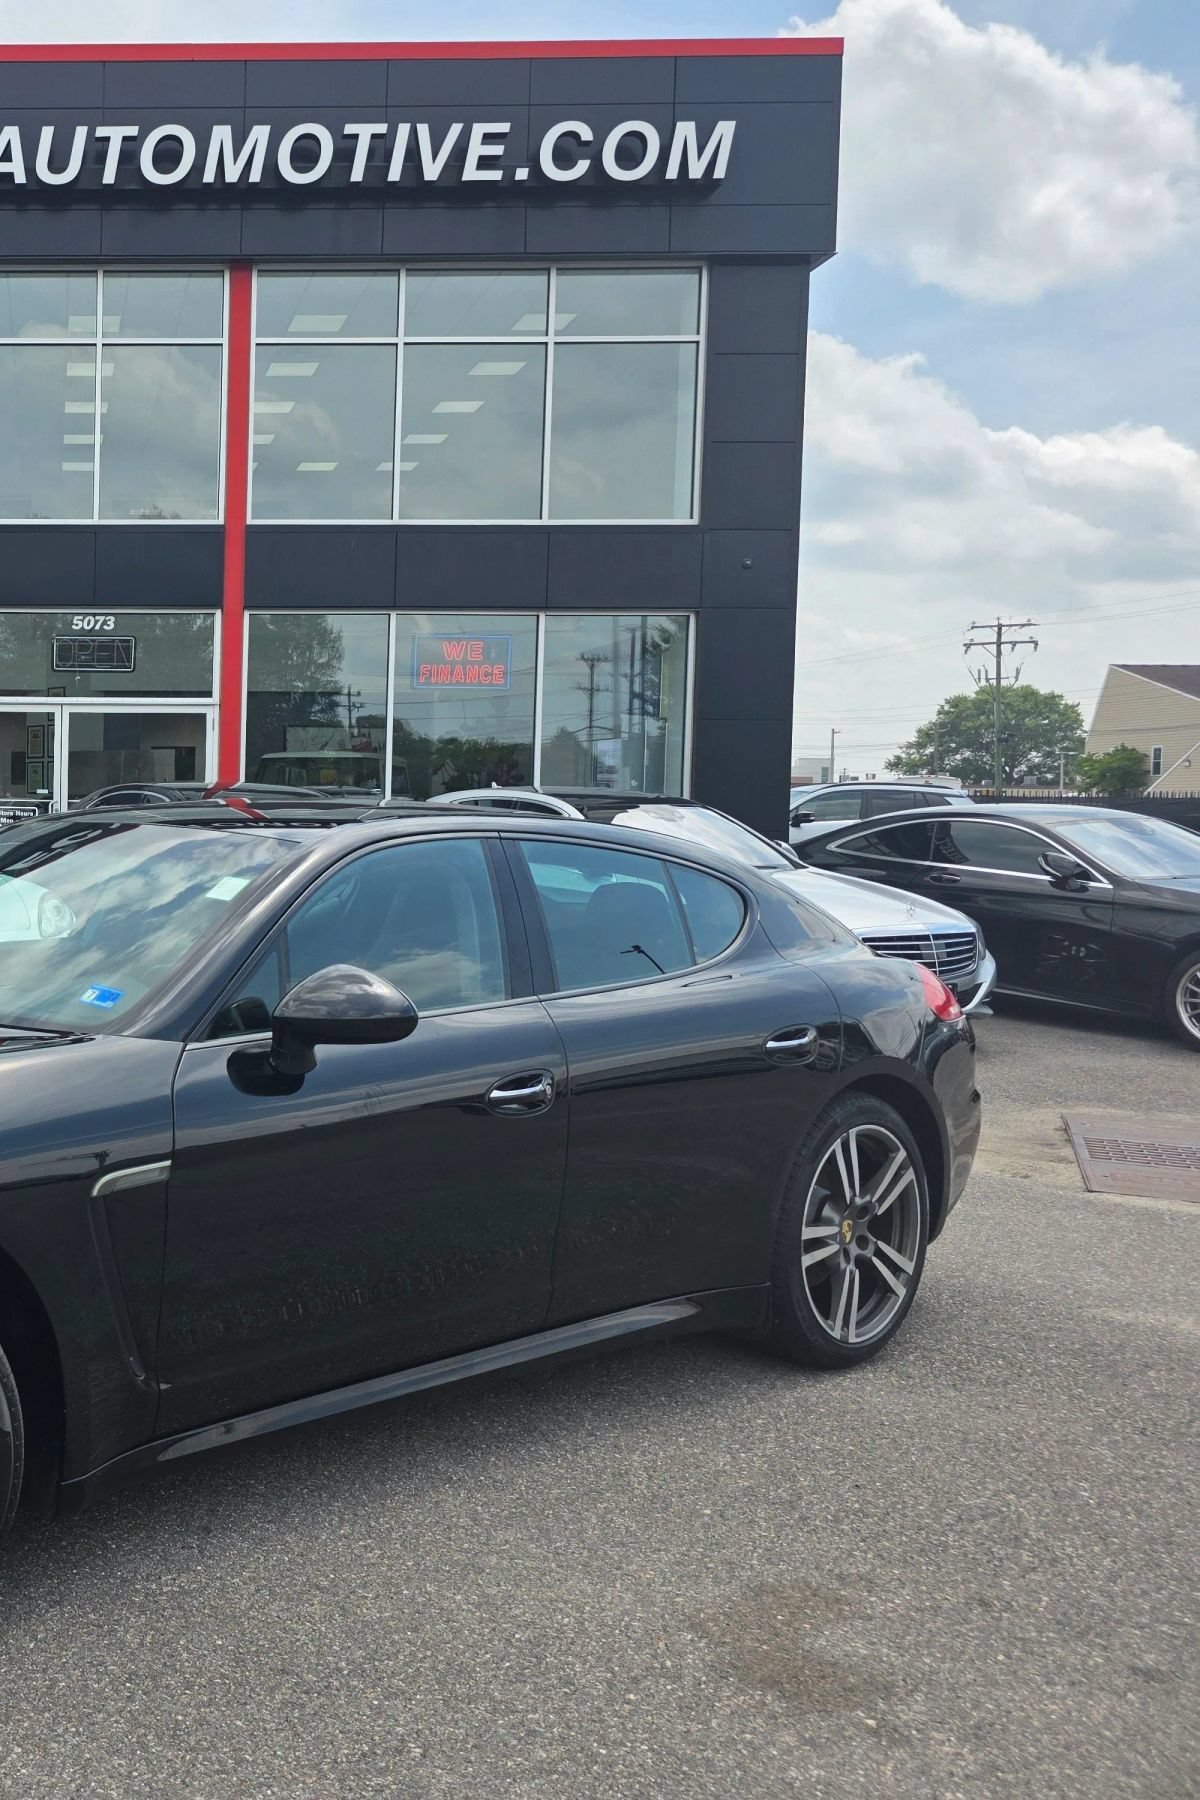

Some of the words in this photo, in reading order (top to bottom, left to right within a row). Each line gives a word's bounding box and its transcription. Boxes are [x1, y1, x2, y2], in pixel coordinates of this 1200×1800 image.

[71, 615, 116, 631] 5073
[56, 638, 132, 669] OPEN
[441, 640, 484, 661] WE
[419, 664, 505, 685] FINANCE
